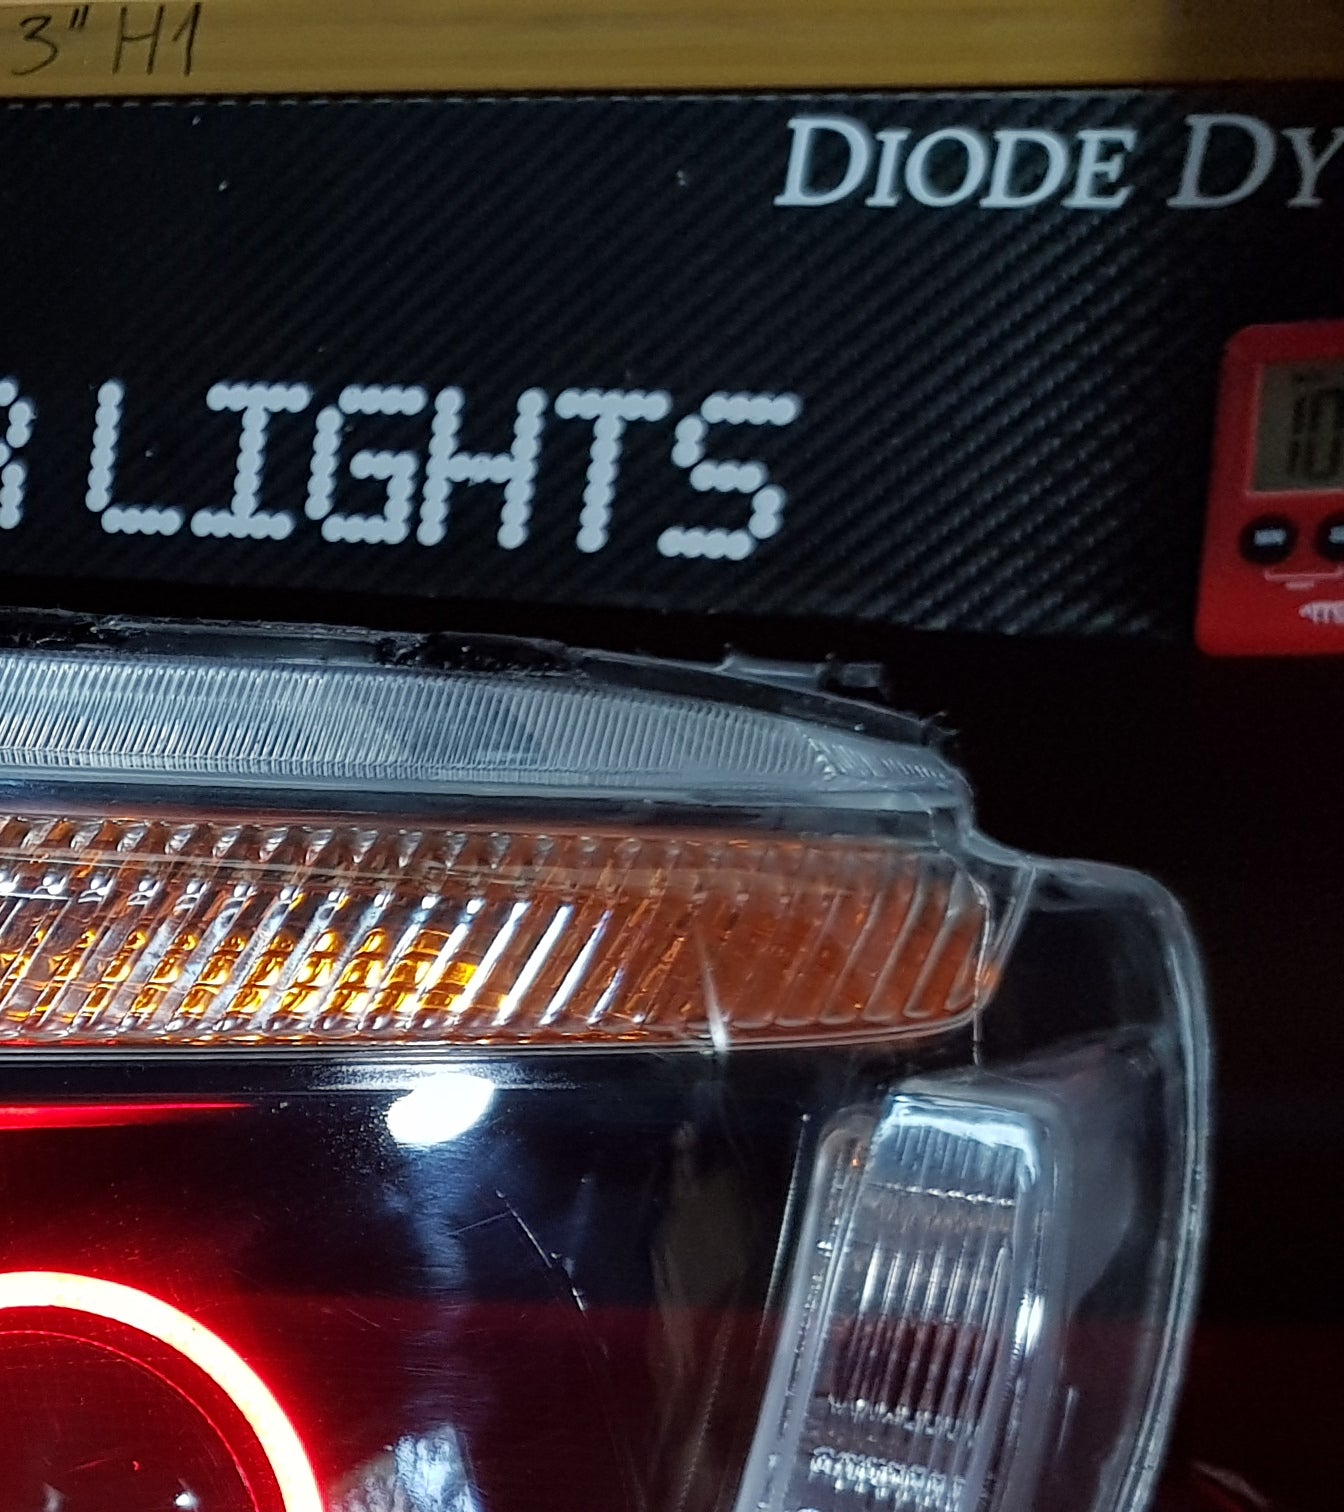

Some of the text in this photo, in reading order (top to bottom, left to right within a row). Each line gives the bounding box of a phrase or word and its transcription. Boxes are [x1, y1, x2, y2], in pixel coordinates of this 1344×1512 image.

[111, 2, 201, 77] H1
[773, 113, 1138, 210] DIODE
[85, 379, 801, 560] LIGHTS
